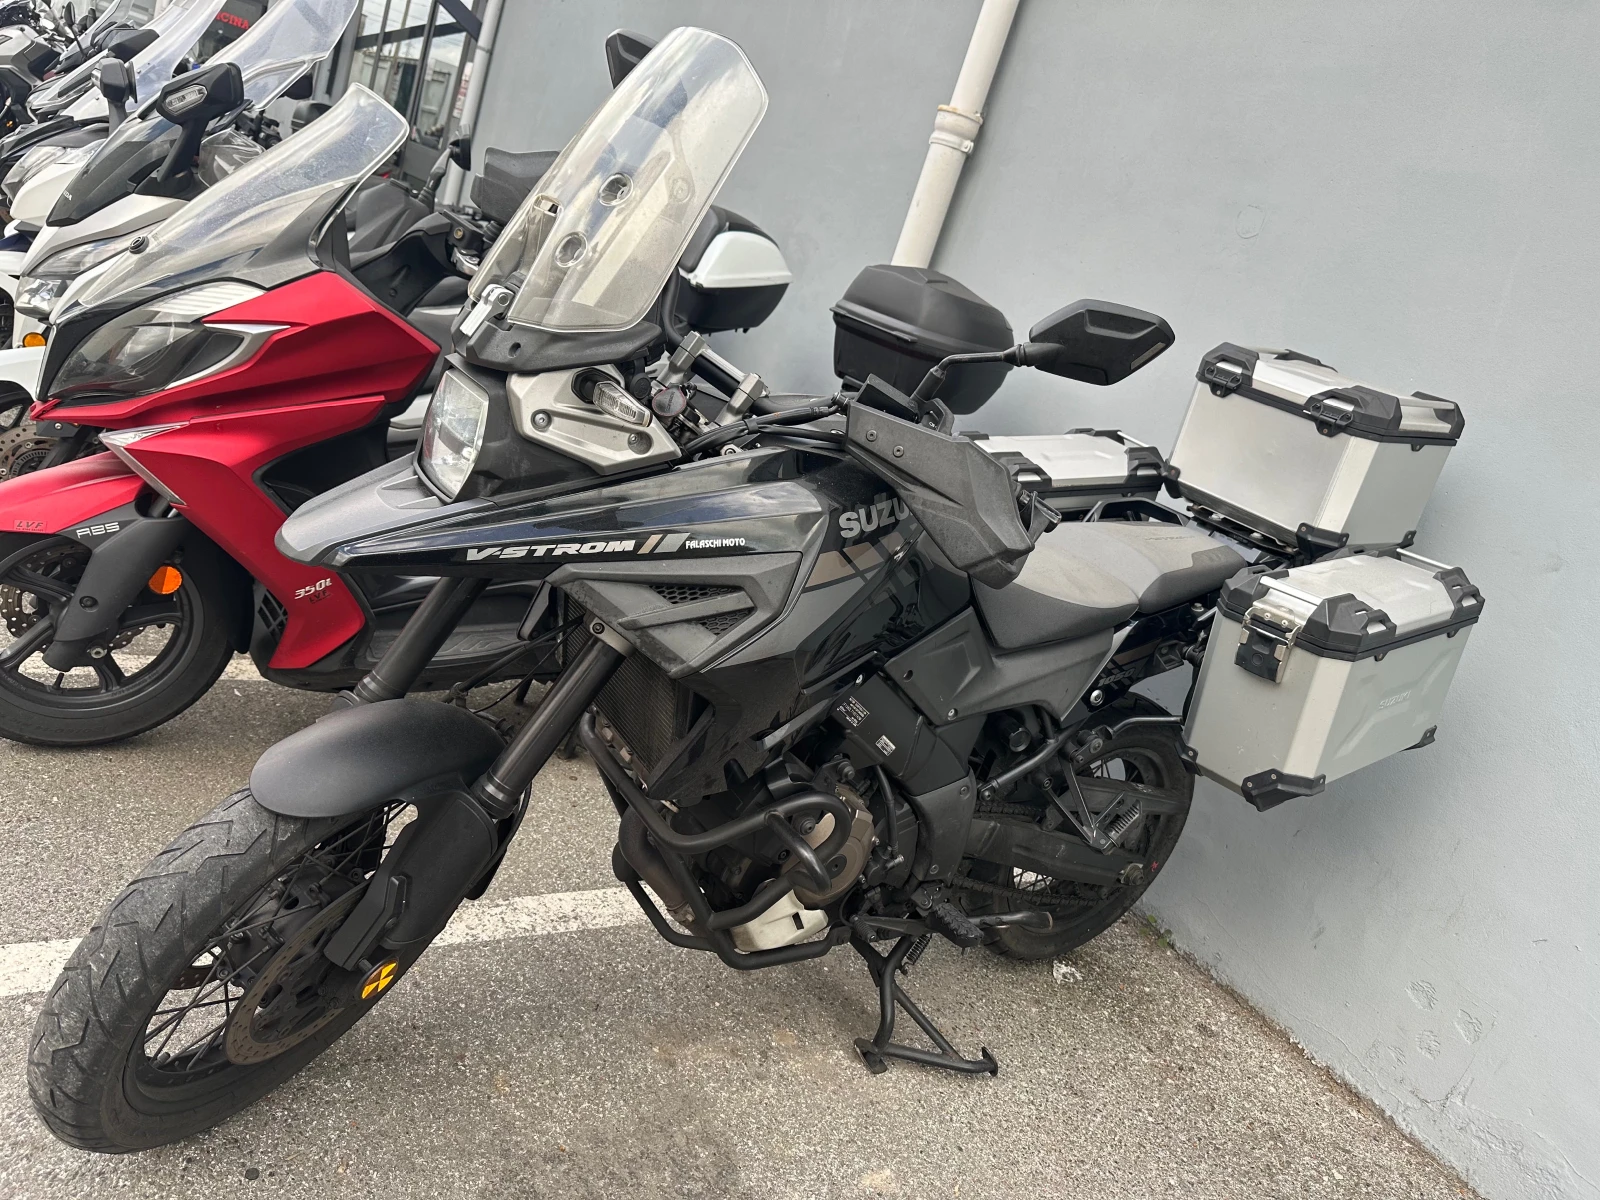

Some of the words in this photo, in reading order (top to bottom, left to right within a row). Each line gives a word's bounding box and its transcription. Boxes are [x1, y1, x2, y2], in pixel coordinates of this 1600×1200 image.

[839, 498, 917, 538] SUZU
[76, 522, 120, 539] ABS
[466, 539, 636, 561] V-STROM
[685, 540, 722, 550] FALASCHI
[722, 537, 746, 547] MOTO
[294, 577, 332, 600] 350i
[1097, 667, 1136, 688] 1050
[1378, 690, 1412, 709] SUZUKI
